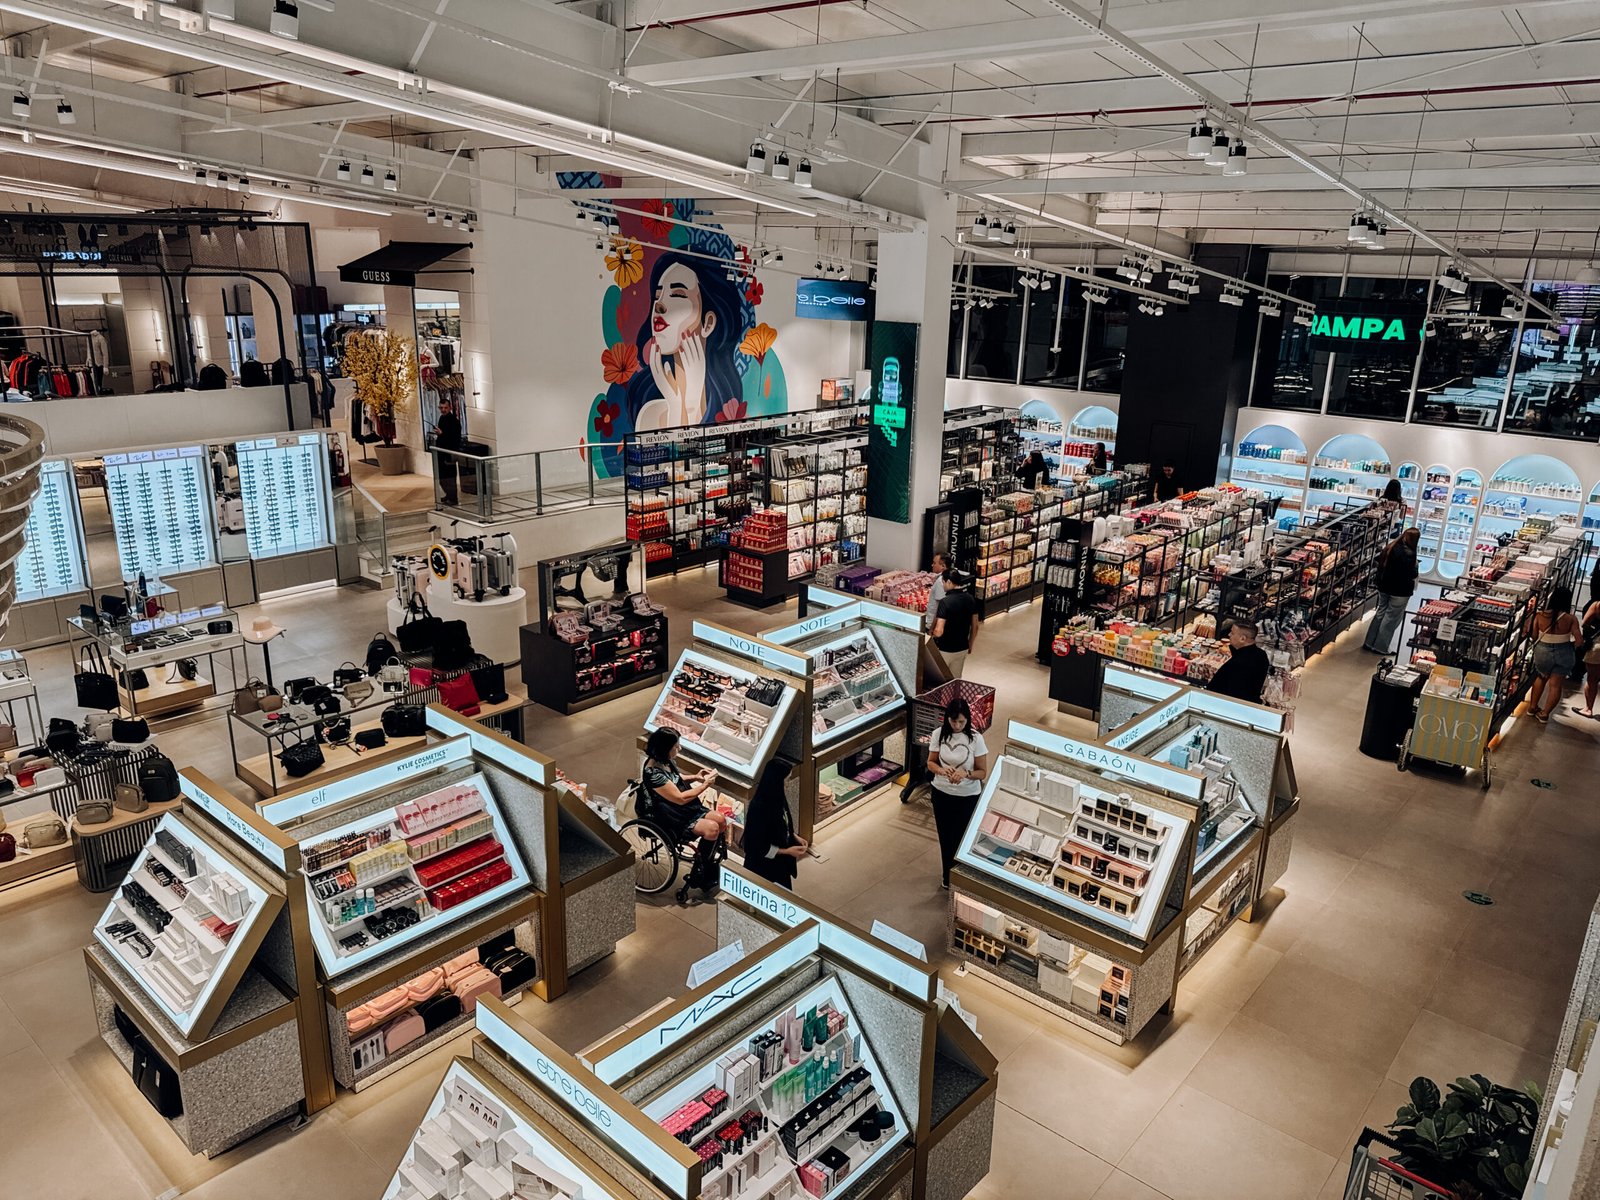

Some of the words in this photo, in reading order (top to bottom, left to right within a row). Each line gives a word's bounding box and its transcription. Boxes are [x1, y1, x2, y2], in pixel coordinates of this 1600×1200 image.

[362, 270, 391, 282] GUESS
[813, 294, 866, 306] belle
[1311, 314, 1406, 341] RAMPA
[645, 433, 669, 443] REVLON
[677, 429, 699, 438] REVLON
[709, 426, 730, 434] REVLON
[950, 514, 960, 562] RINOWS
[1077, 546, 1089, 599] RINOWS
[798, 615, 832, 635] NOTE
[728, 636, 766, 659] NOTE
[1113, 727, 1140, 748] LANEIGE
[396, 761, 415, 772] KYLIE
[1063, 742, 1137, 774] GABAÓN
[226, 811, 242, 831] Rare
[241, 823, 265, 851] Beauty
[722, 871, 778, 914] Fillerina
[536, 1057, 573, 1096] etre
[573, 1084, 612, 1129] belle
